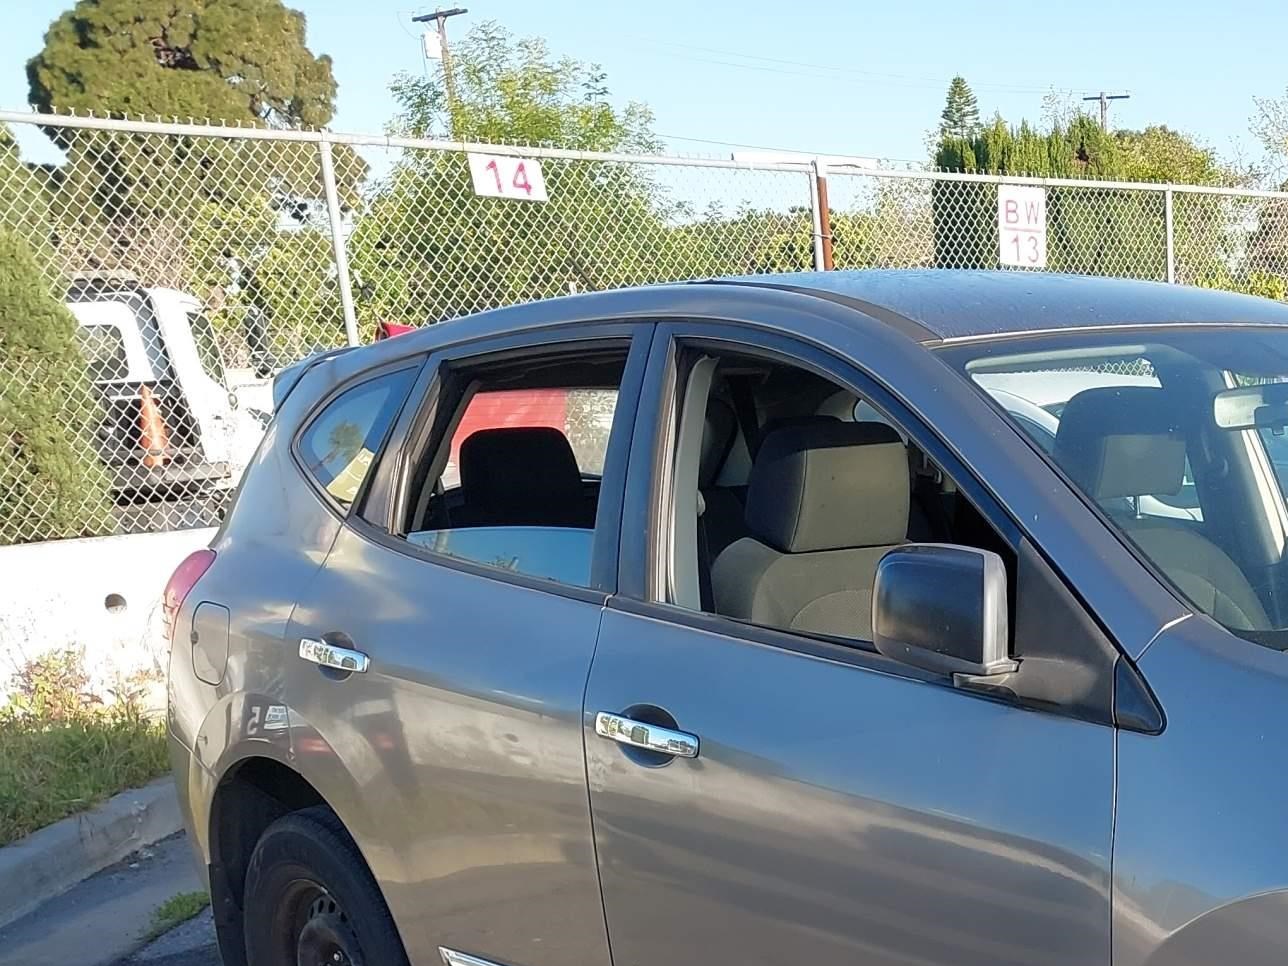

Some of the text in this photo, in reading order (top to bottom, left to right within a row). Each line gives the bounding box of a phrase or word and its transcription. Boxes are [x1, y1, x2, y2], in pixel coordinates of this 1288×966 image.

[485, 160, 532, 195] 14
[1004, 199, 1040, 225] BW
[1011, 234, 1039, 263] 13
